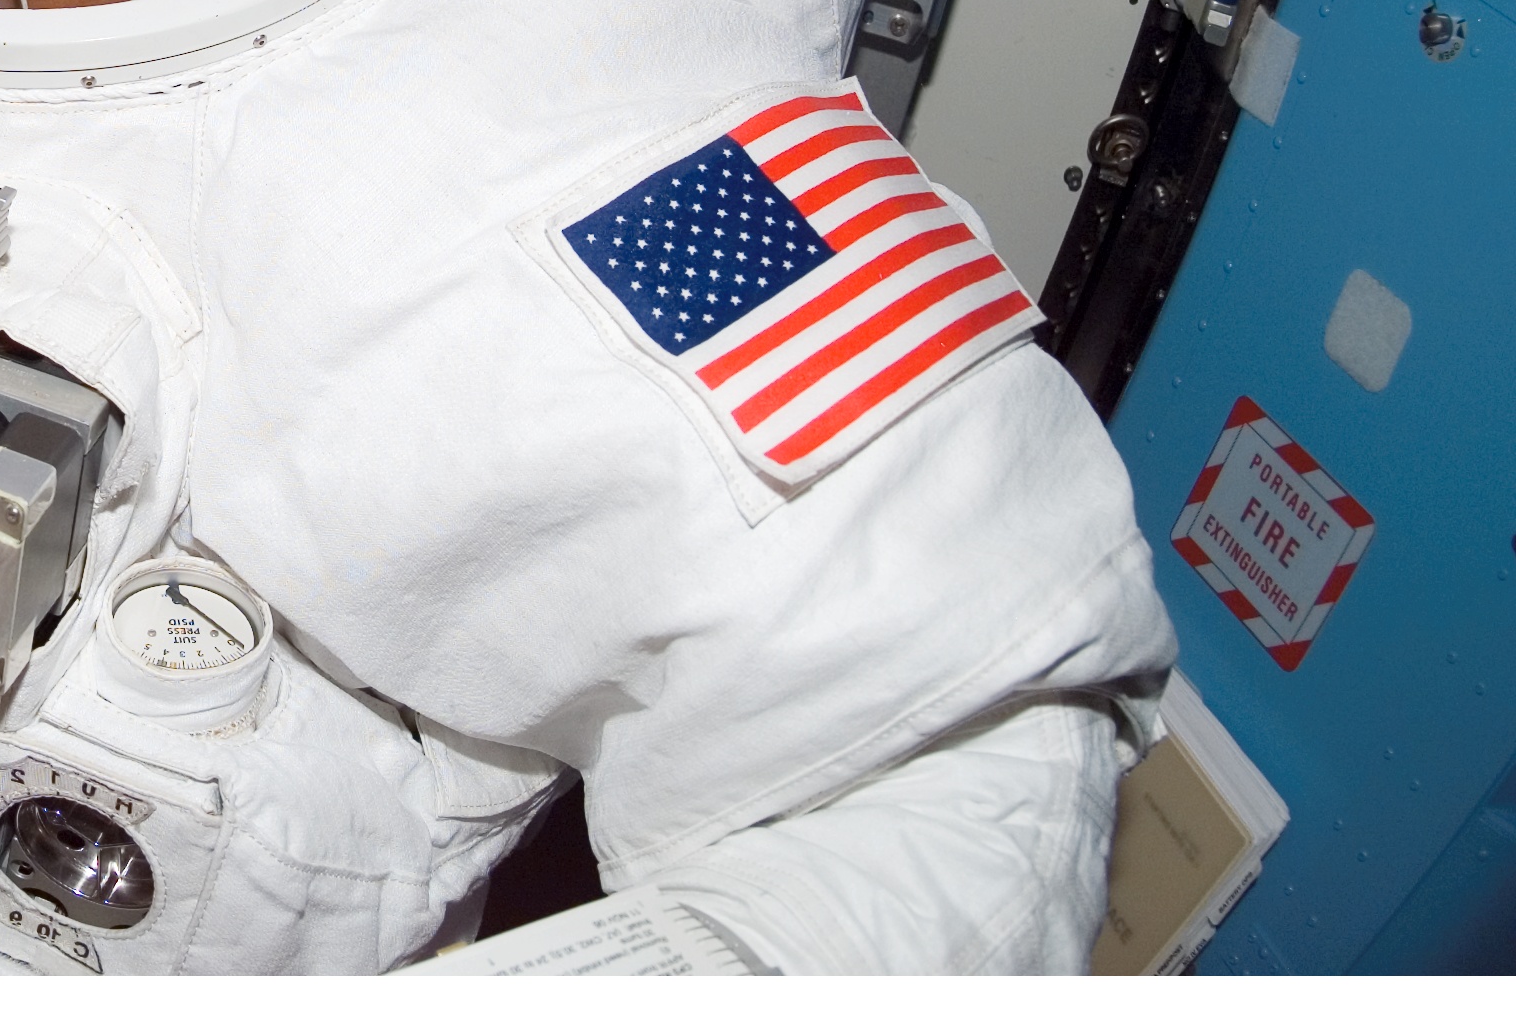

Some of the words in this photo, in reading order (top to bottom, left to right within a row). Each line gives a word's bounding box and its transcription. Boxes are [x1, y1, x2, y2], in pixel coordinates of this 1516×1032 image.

[1240, 495, 1301, 569] FIRE
[1249, 453, 1330, 541] PORTABLE
[1202, 513, 1299, 622] EXTINGUISHER
[167, 627, 200, 635] PRESS
[173, 636, 197, 644] SUIT
